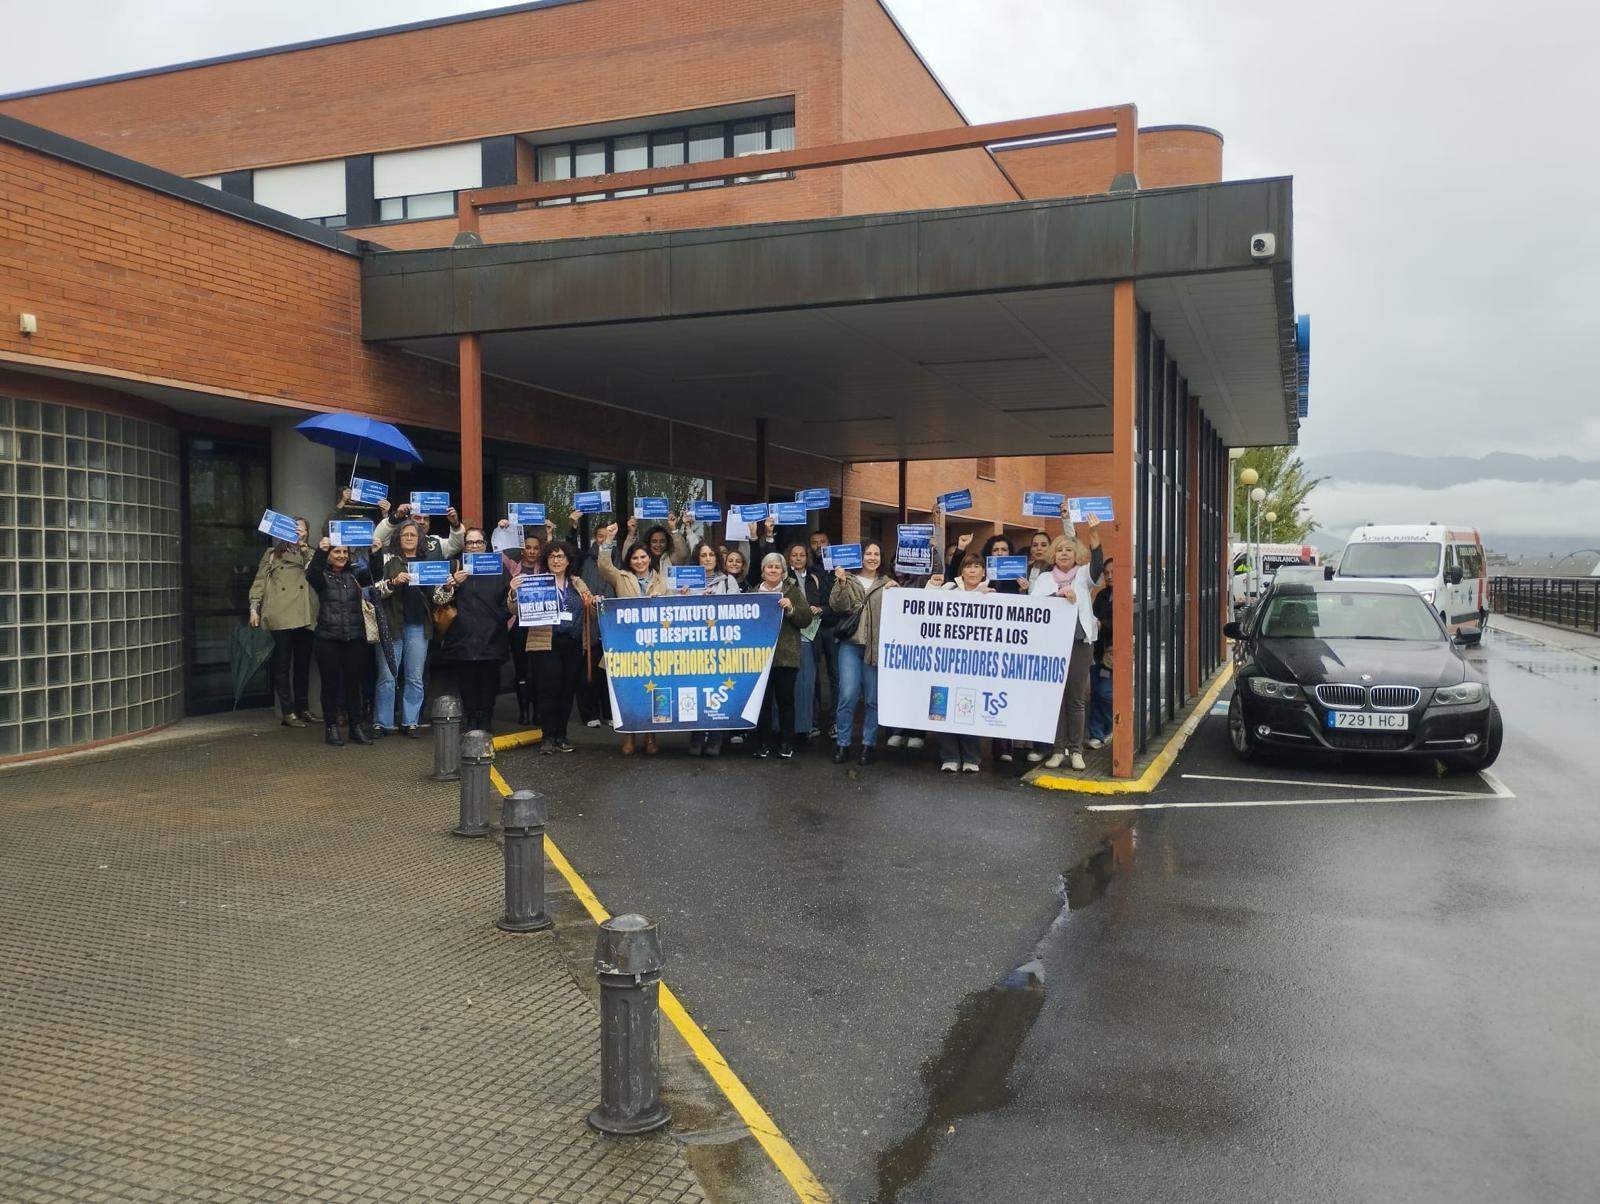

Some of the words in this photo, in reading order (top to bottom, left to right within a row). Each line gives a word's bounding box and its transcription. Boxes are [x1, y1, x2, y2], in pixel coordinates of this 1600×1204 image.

[616, 607, 640, 624] POR
[641, 606, 657, 622] UN
[660, 604, 716, 623] ESTATUTO
[718, 603, 760, 620] MARCO
[903, 599, 925, 615] POR
[928, 601, 943, 617] UN
[946, 602, 1002, 621] ESTATUTO
[1006, 606, 1051, 624] MARCO
[635, 627, 659, 645] QUE
[660, 626, 708, 643] RESPETE
[709, 626, 718, 642] A
[720, 625, 741, 641] LOS
[920, 622, 941, 639] QUE
[944, 624, 993, 642] RESPETE
[994, 628, 1004, 643] A
[1006, 629, 1028, 645] LOS
[653, 648, 717, 677] SUPERIORES
[884, 639, 932, 671] TÉCNICOS
[934, 646, 999, 678] SUPERIORES
[1001, 652, 1067, 684] SANITARIOS
[703, 685, 729, 710] TSS
[982, 691, 1008, 716] TSS
[1339, 713, 1373, 727] 7291
[1379, 715, 1405, 728] HCJ
